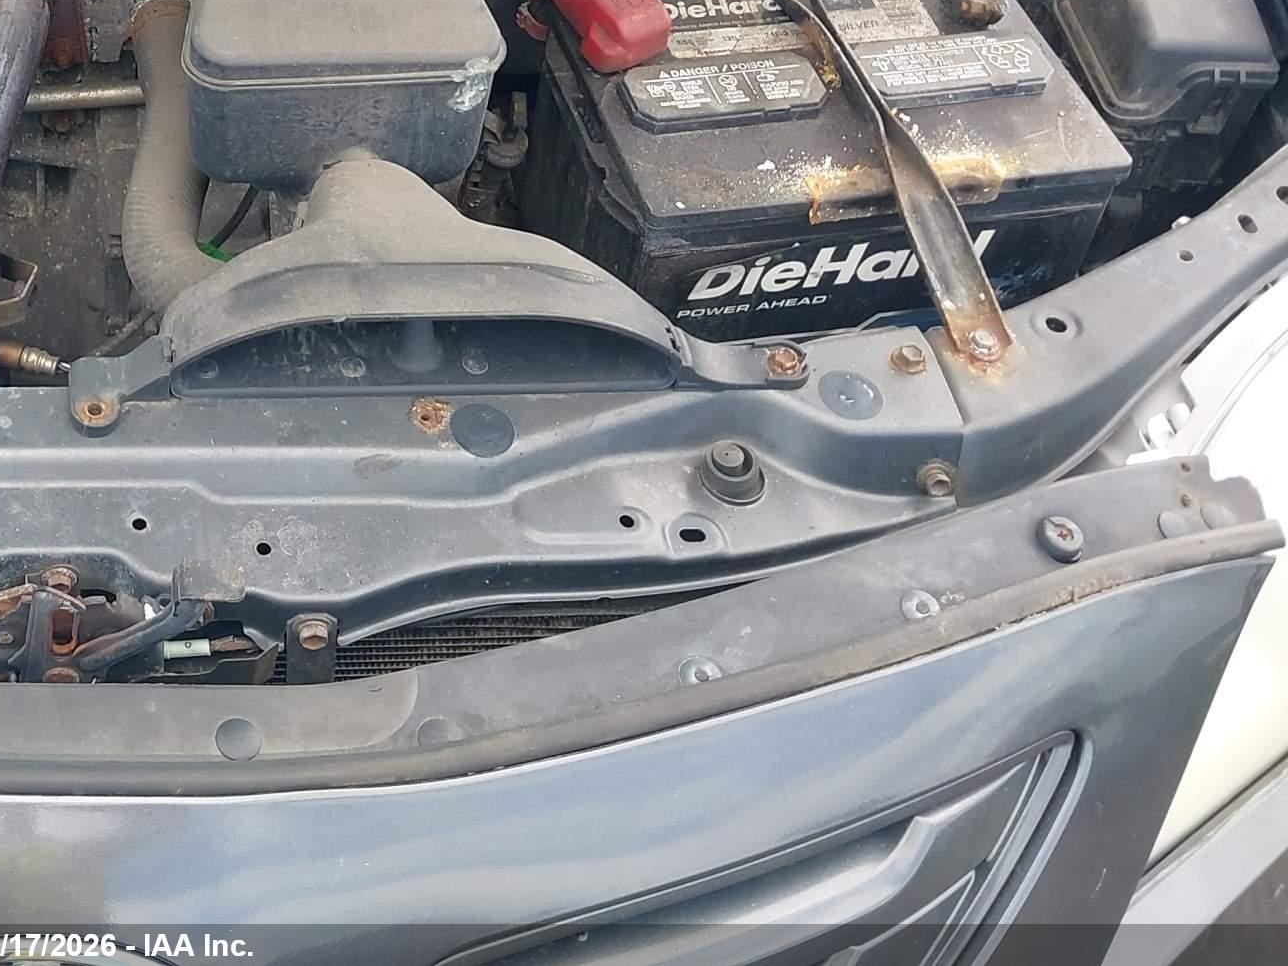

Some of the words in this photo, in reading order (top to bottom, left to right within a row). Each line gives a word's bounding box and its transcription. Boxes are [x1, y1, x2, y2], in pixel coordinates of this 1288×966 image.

[838, 19, 879, 32] SILVER
[667, 65, 720, 79] DANGER
[730, 59, 776, 72] POISON
[676, 303, 751, 319] POWER
[755, 295, 827, 311] AHEAD
